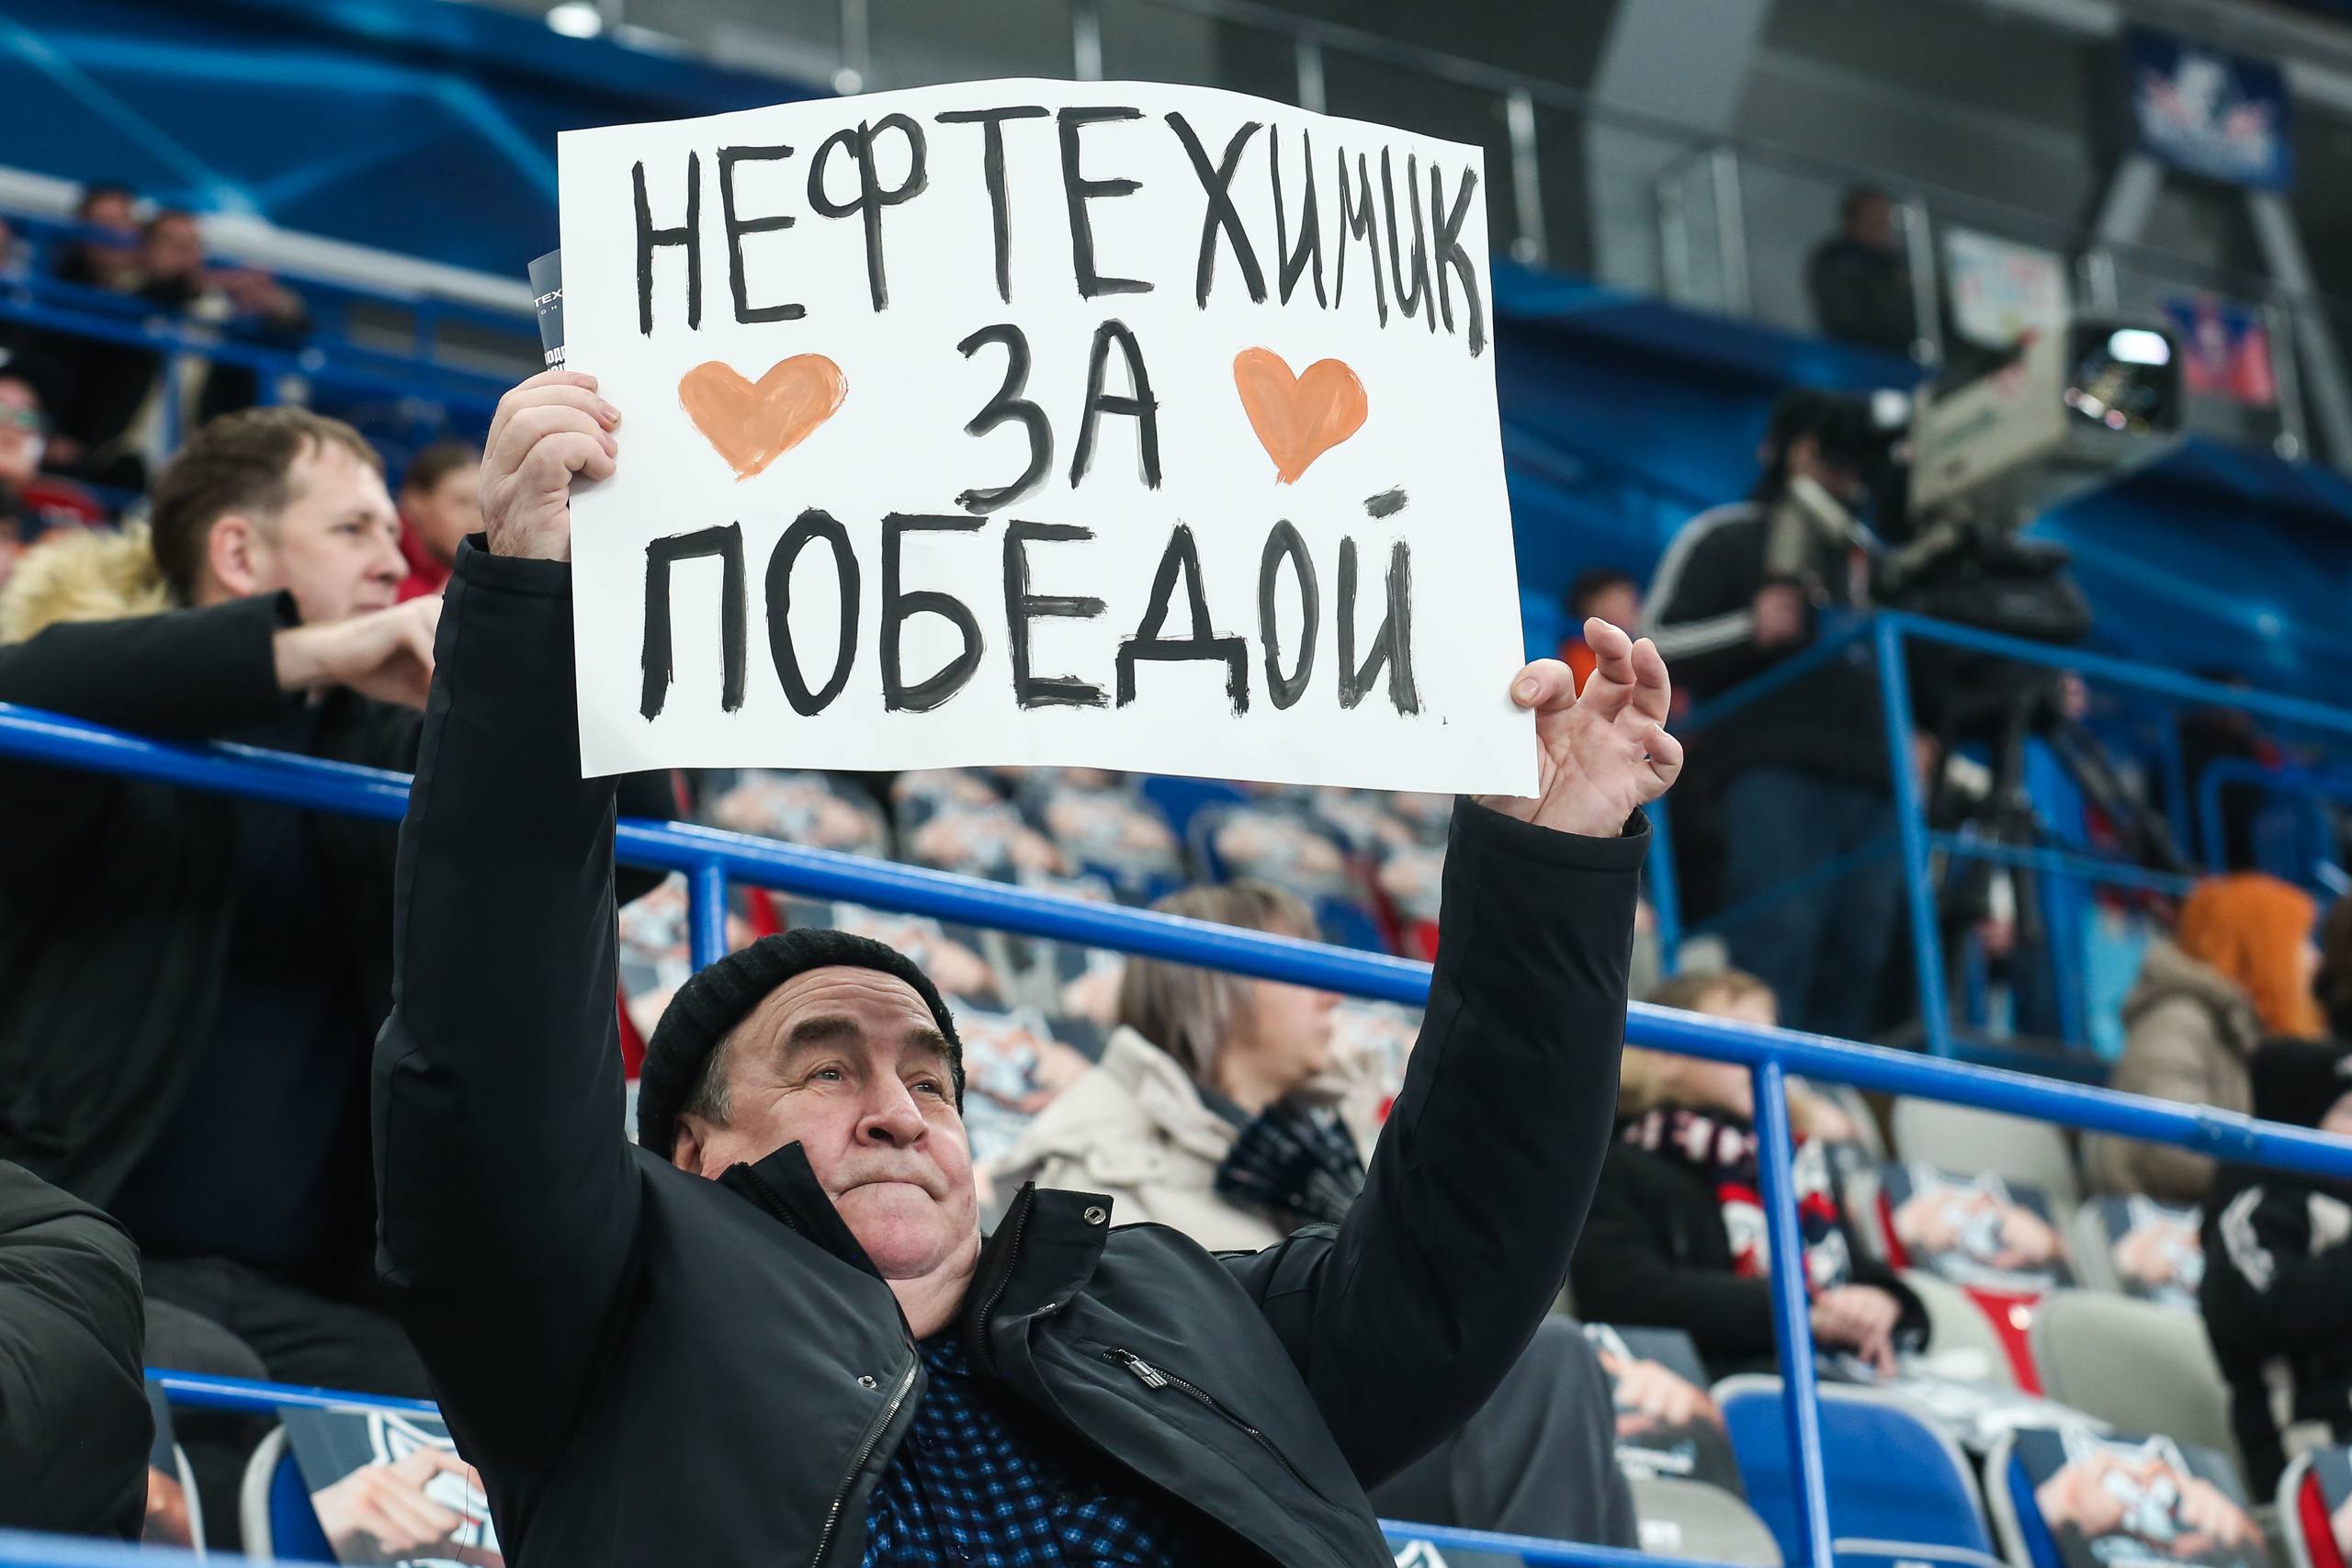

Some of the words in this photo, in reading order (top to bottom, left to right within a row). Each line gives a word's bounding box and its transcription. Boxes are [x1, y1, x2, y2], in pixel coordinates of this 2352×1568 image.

[631, 105, 1486, 359] НЕФТЕХИМИК
[954, 318, 1163, 514] ЗА
[639, 486, 1420, 723] ПОБЕДОЙ
